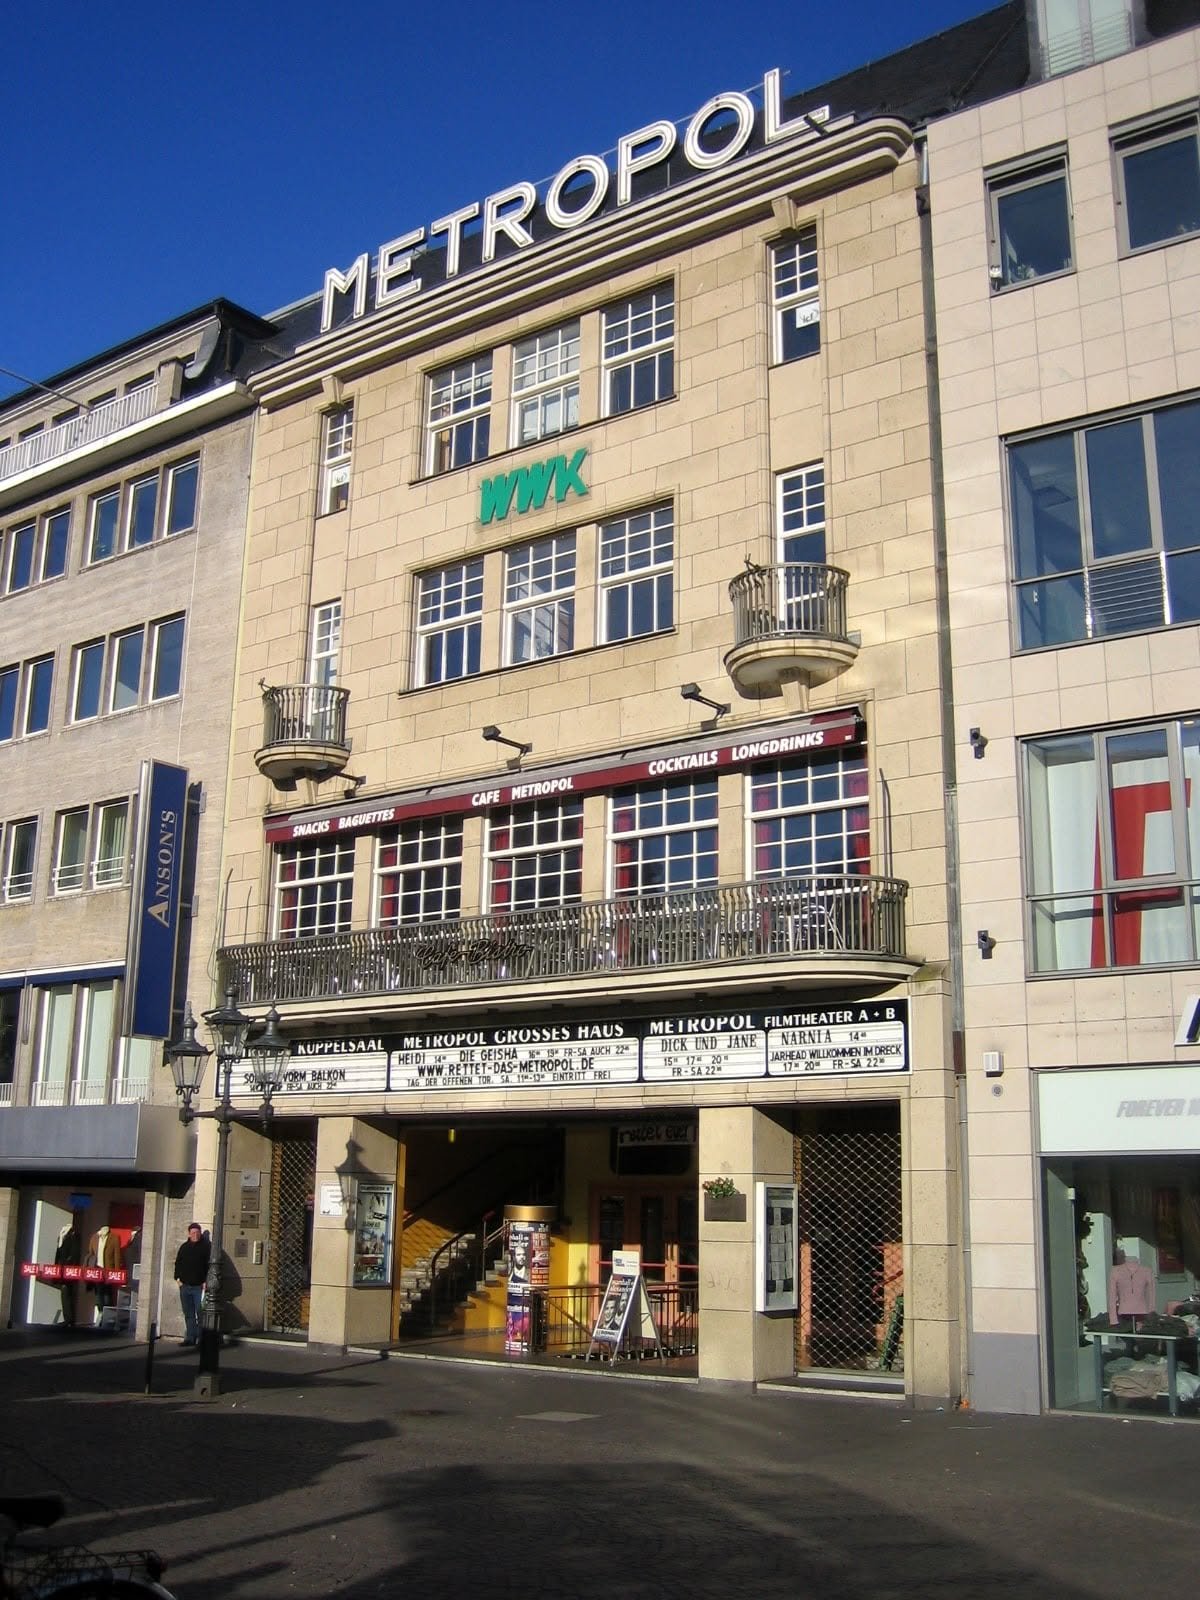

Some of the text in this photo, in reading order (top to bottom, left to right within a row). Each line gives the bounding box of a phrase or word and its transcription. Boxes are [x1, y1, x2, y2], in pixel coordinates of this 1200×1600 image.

[319, 67, 830, 334] METROPOL
[480, 447, 590, 526] WWK
[292, 731, 825, 838] SNACKS BAGUETTES CAFE METROPOL COCKTAILS LONGDRINKS
[148, 809, 177, 928] ANSON'S
[650, 1014, 756, 1034] METROPOL
[764, 1011, 853, 1028] FILMTHEATER
[858, 1009, 868, 1021] A
[886, 1007, 896, 1019] B
[298, 1037, 385, 1055] KUPPELSAAL
[403, 1023, 624, 1049] METROPOL GROSSES HAUS
[661, 1033, 757, 1053] DICK UND JANE
[781, 1029, 832, 1046] NARNIA
[398, 1052, 426, 1065] HEIDI
[460, 1049, 476, 1062] DIE
[480, 1048, 518, 1061] GEISHA
[563, 1047, 587, 1057] FR-SA
[590, 1046, 611, 1056] AUCH
[770, 1044, 902, 1062] JARHEAD WILLKOMMEN IM DRECK
[283, 1070, 307, 1083] VORM
[311, 1069, 346, 1082] BALKON
[417, 1057, 595, 1078] WWW.RETTET-DAS-METROPOL.DE
[407, 1078, 420, 1087] TAG
[425, 1077, 438, 1087] DER
[442, 1076, 473, 1086] OFFENEN
[552, 1072, 586, 1081] EINTRITT
[593, 1071, 611, 1080] FREI
